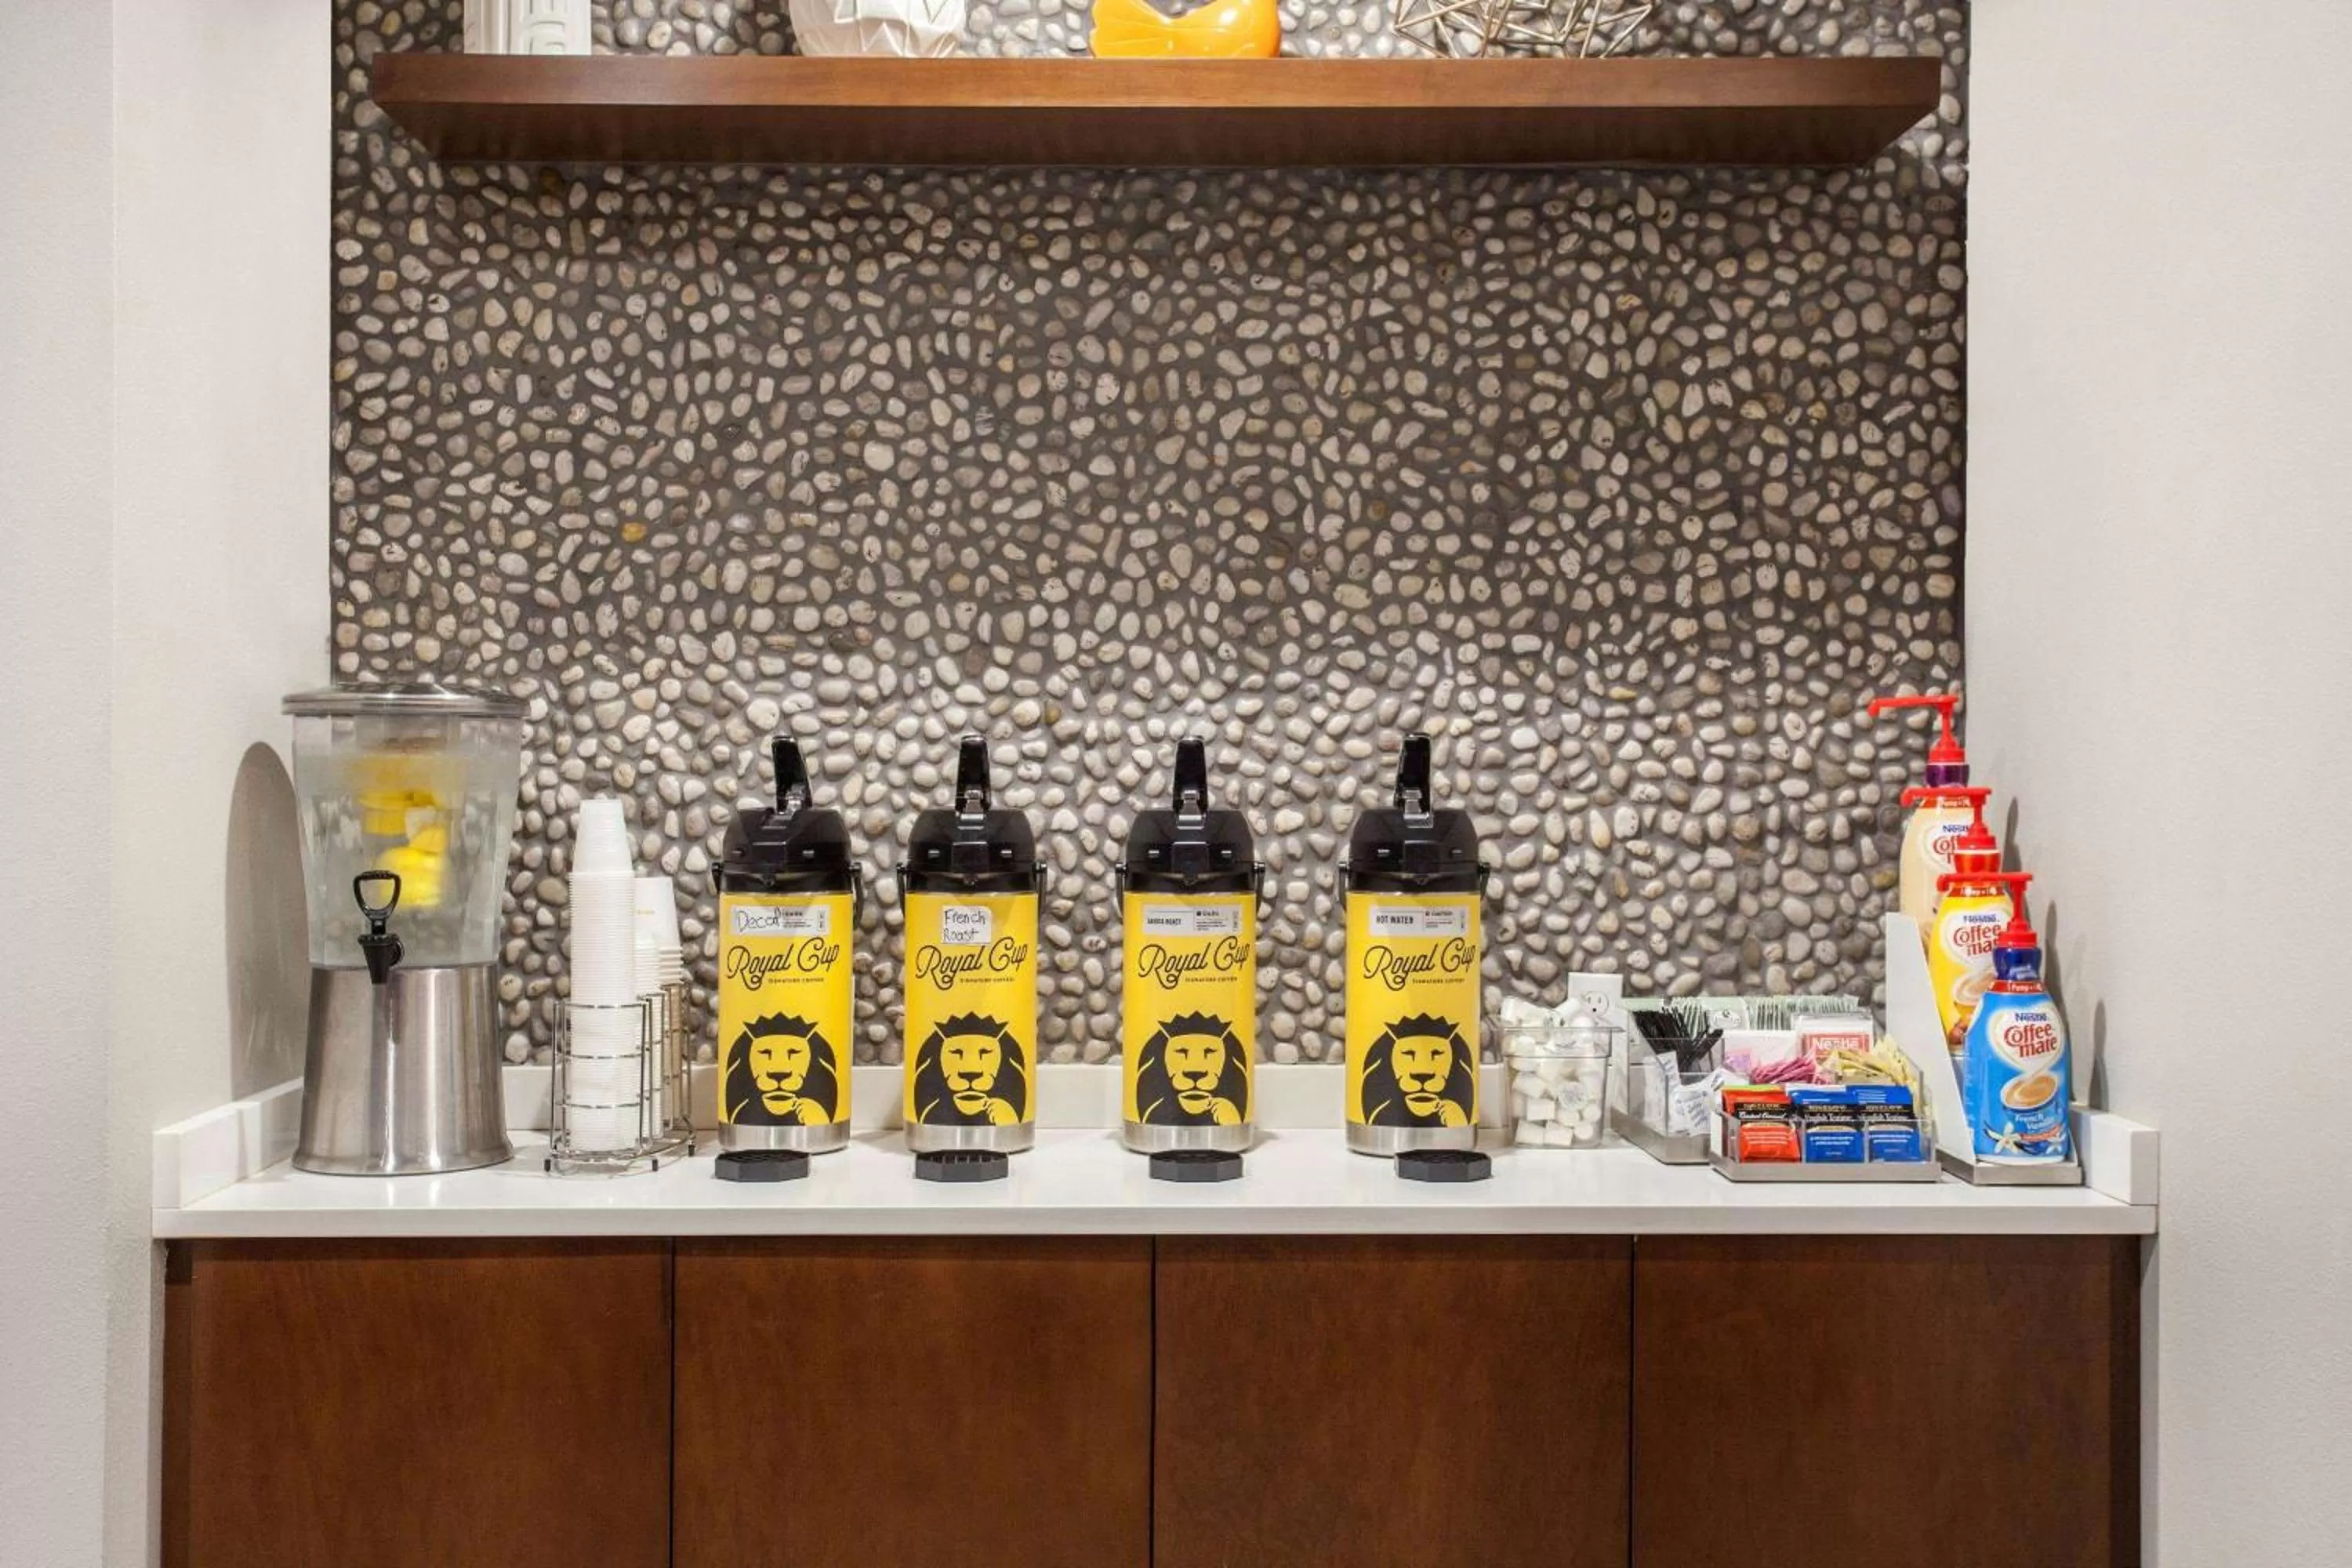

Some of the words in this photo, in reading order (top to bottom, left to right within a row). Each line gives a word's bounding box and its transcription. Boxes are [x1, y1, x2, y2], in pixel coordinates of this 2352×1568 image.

[1933, 835, 1961, 855] Cof
[944, 909, 985, 925] French
[943, 927, 979, 942] Roast
[1953, 925, 2001, 947] Coffee
[1966, 938, 1998, 956] mat
[727, 943, 794, 991] Royal
[797, 937, 840, 972] Cup
[916, 945, 985, 990] Royal
[989, 936, 1028, 972] Cup
[1138, 942, 1211, 989] Royal
[1214, 935, 1250, 971] Cup
[1364, 943, 1439, 991] Royal
[1441, 937, 1475, 972] Cup
[2004, 1023, 2052, 1047] Coffee
[2019, 1036, 2058, 1058] mate
